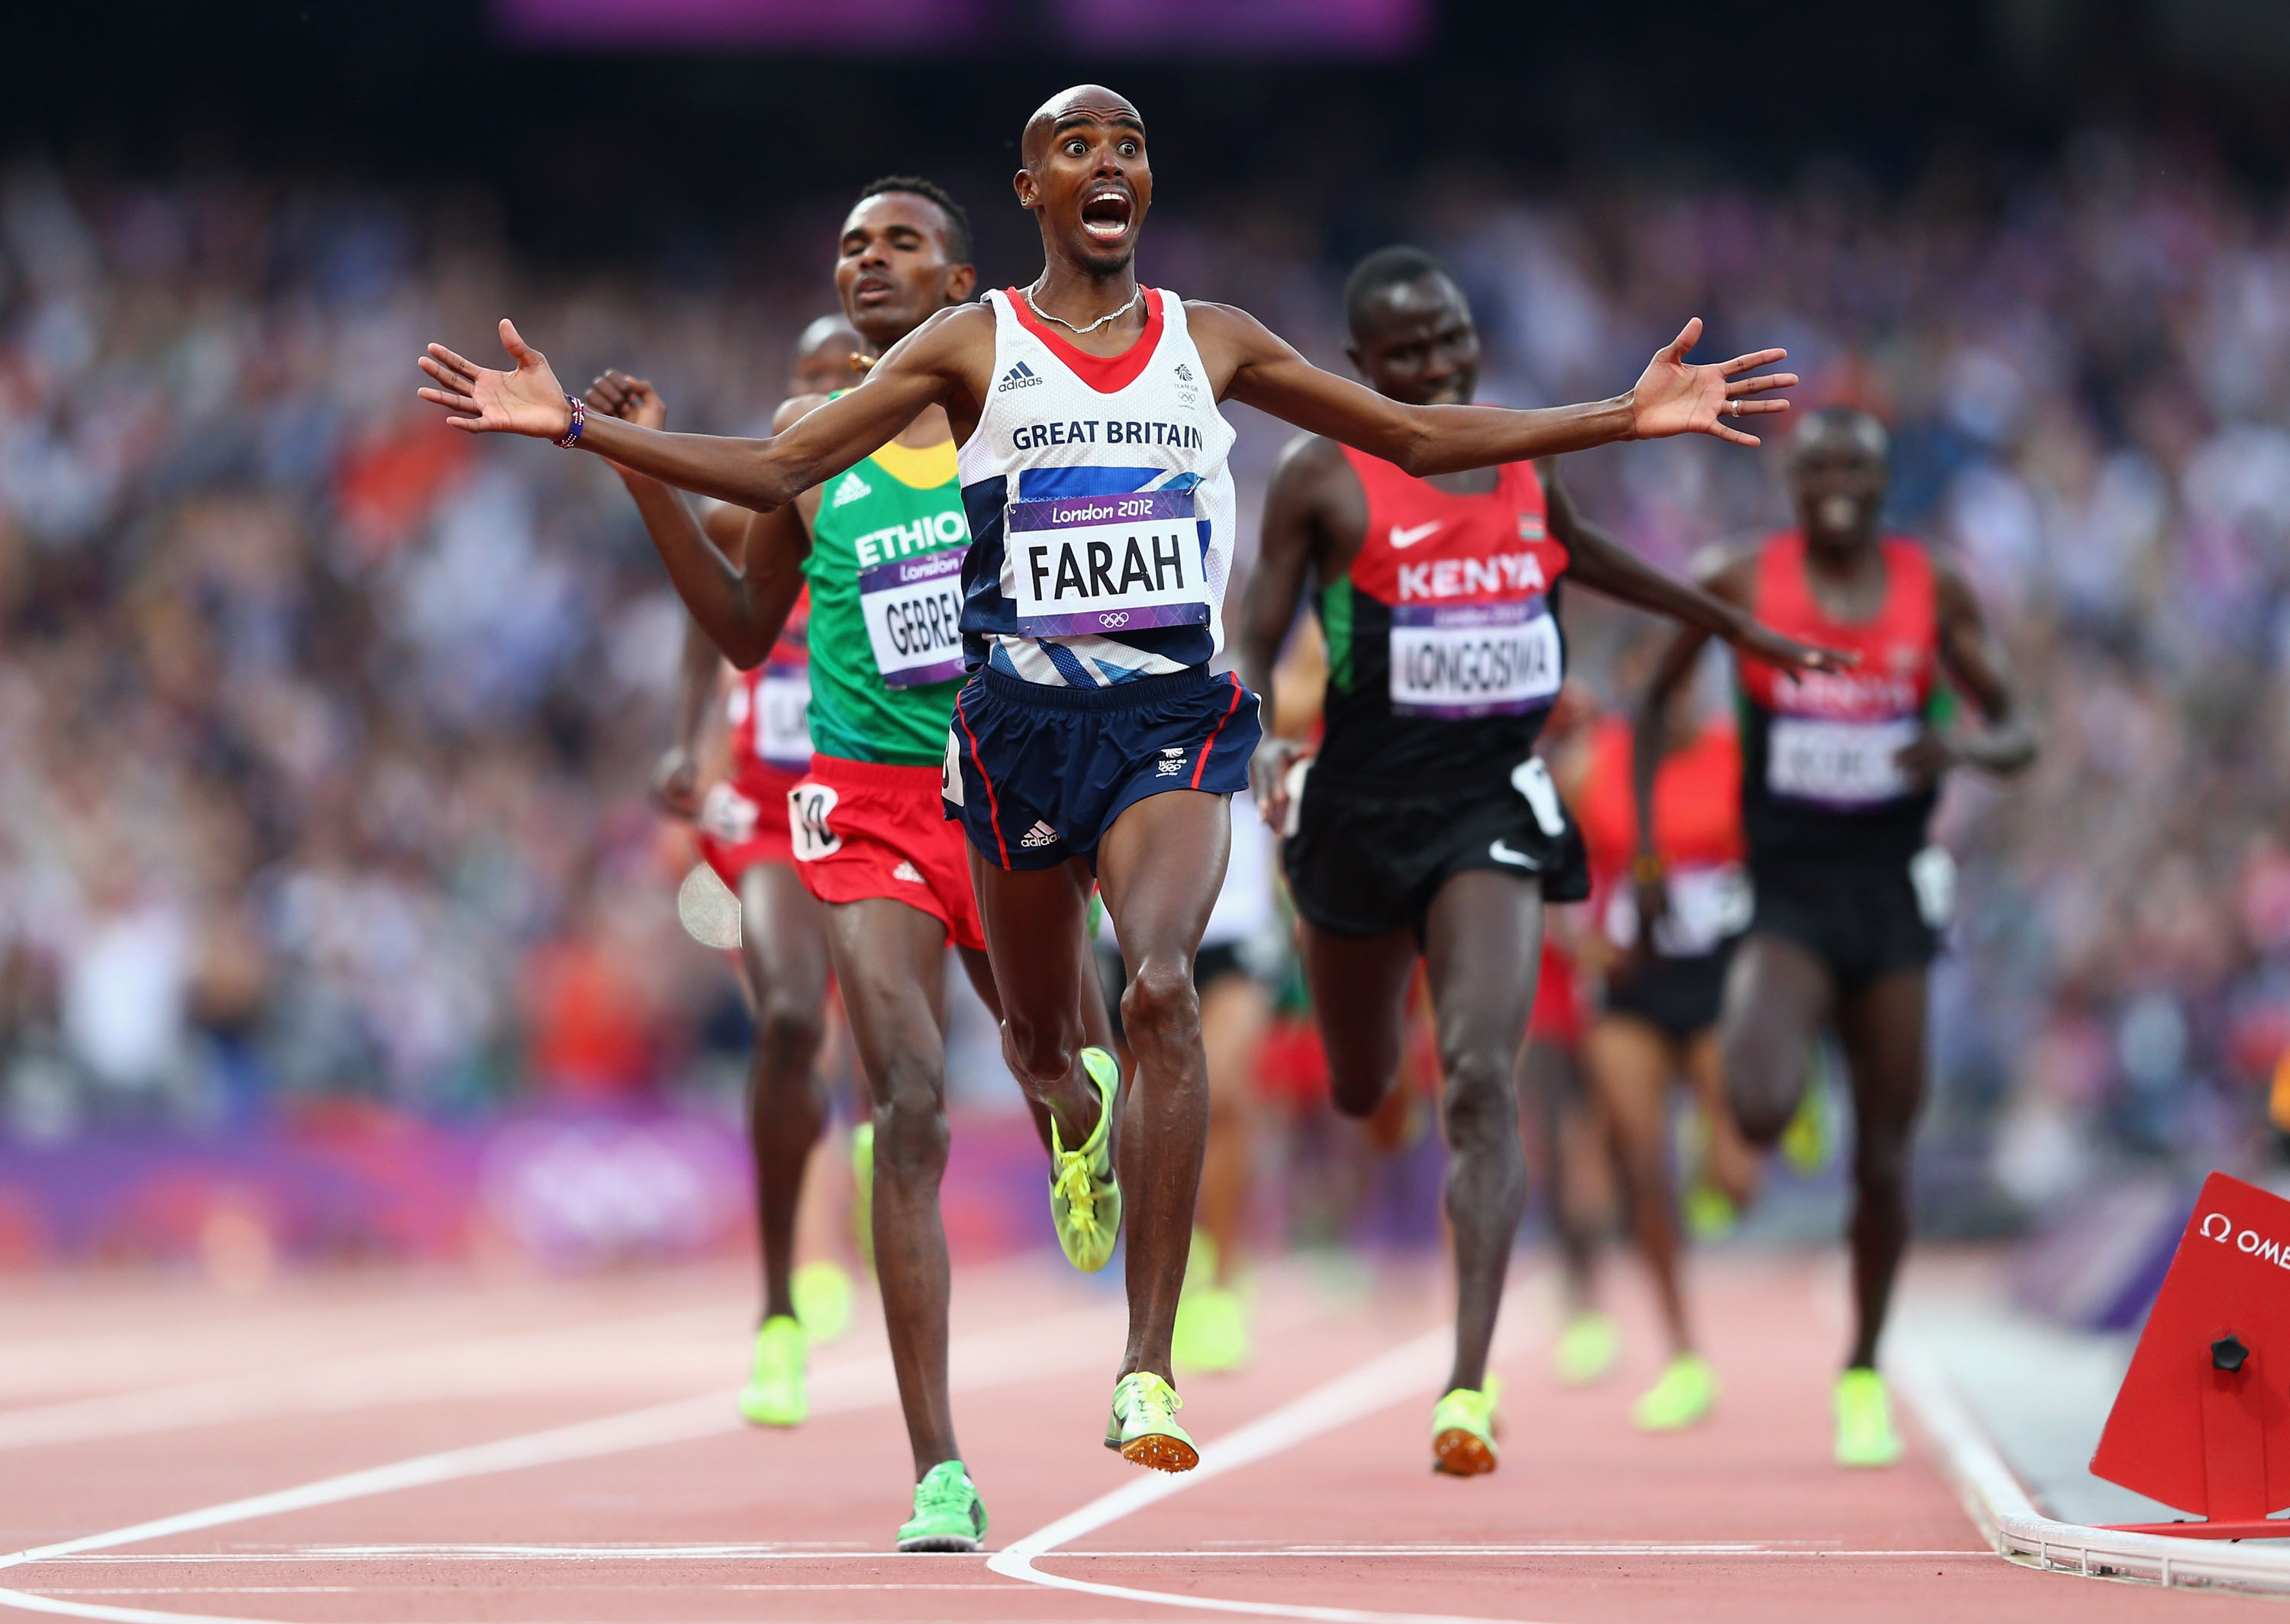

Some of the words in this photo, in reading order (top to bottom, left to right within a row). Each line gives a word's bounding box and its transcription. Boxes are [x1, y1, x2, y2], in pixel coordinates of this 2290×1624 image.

[998, 375, 1043, 392] adidas
[1012, 420, 1099, 450] GREAT
[1107, 420, 1203, 451] BRITAIN
[1052, 504, 1114, 524] London
[1118, 499, 1154, 517] 2012
[854, 511, 972, 568] ETHIO
[900, 555, 959, 582] London
[1028, 534, 1184, 601] FARAH
[1397, 552, 1546, 601] KENYA
[886, 590, 962, 656] GEBRE
[1021, 833, 1060, 847] adida
